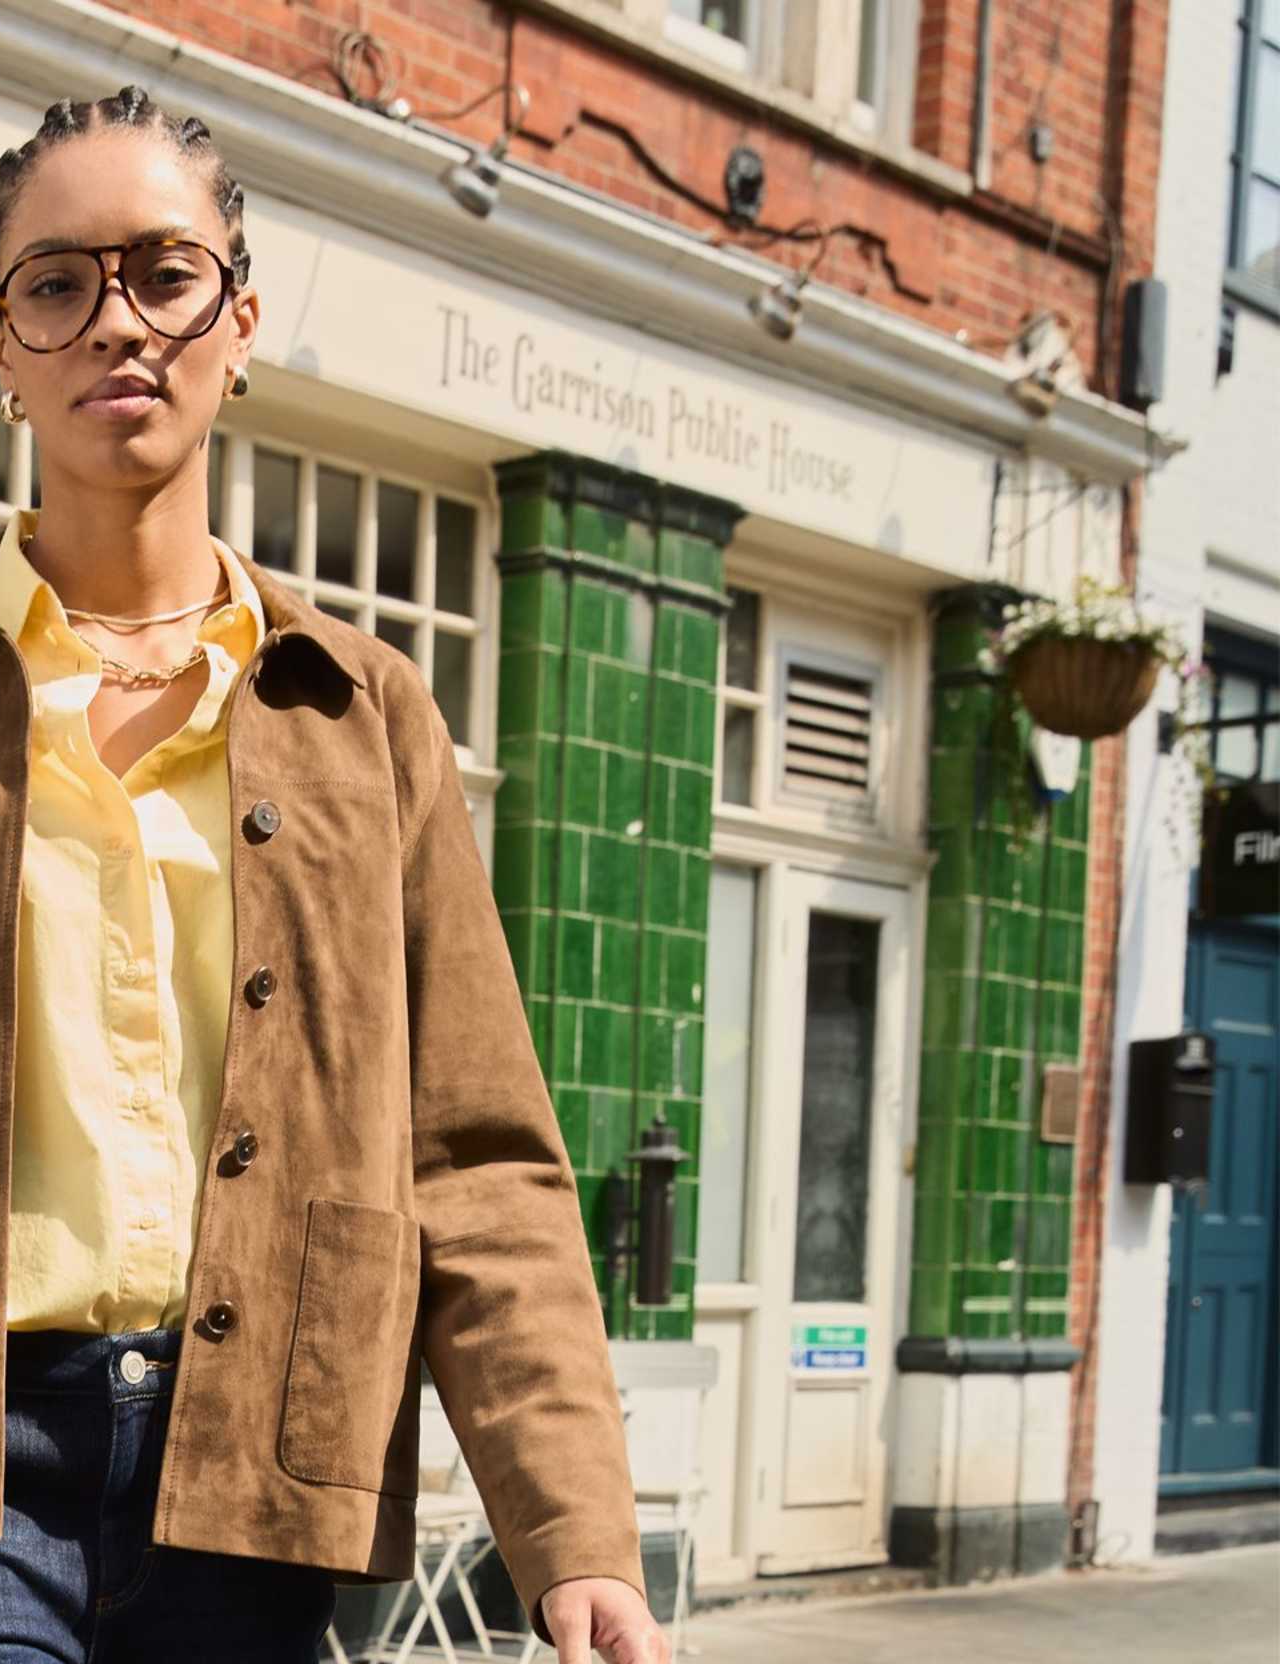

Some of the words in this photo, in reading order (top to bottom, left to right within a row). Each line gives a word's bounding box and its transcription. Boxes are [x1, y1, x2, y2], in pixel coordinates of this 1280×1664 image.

[436, 304, 501, 388] The
[510, 331, 656, 440] Garrison
[667, 385, 760, 471] Public
[769, 421, 855, 500] House
